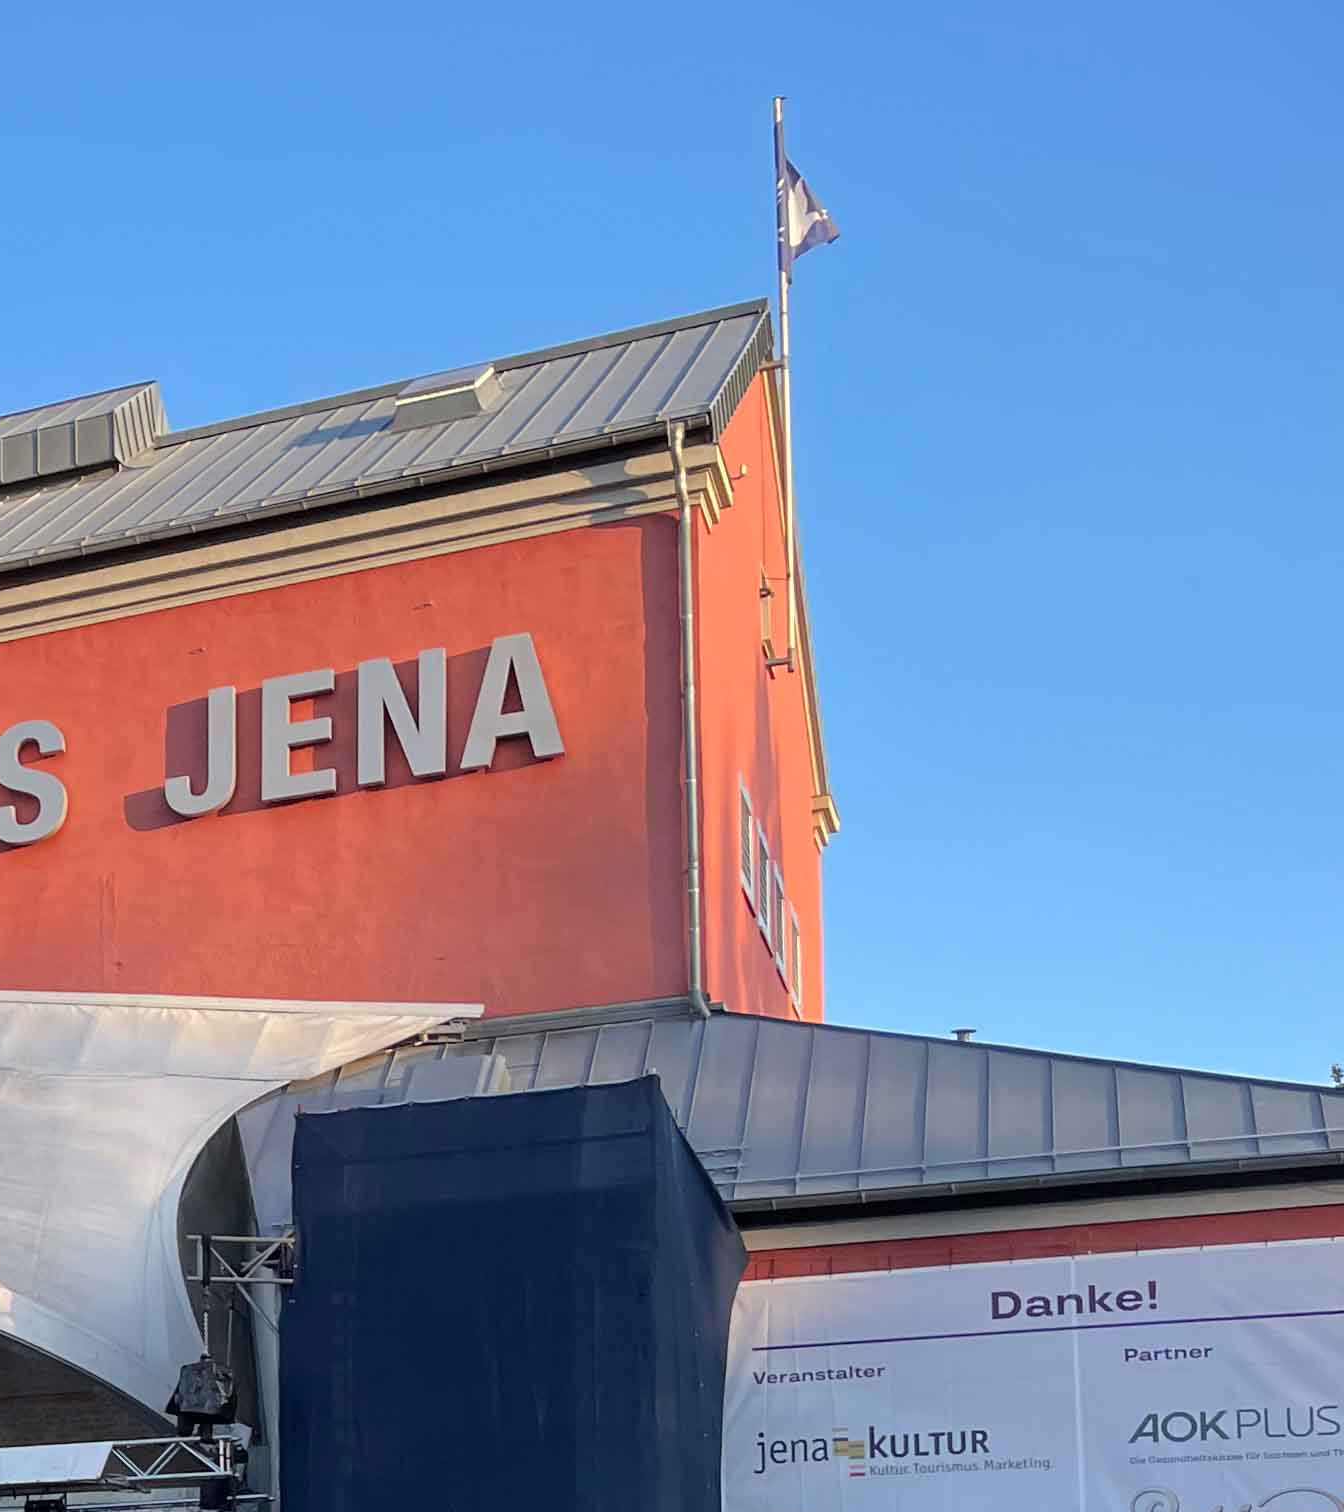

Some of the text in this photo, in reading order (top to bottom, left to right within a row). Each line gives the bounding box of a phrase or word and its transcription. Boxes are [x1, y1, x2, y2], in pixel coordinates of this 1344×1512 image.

[162, 630, 568, 820] JENA
[991, 1280, 1158, 1320] Danke!
[1124, 1346, 1214, 1362] Partner
[752, 1365, 886, 1385] Veranstalter
[753, 1432, 829, 1474] jena
